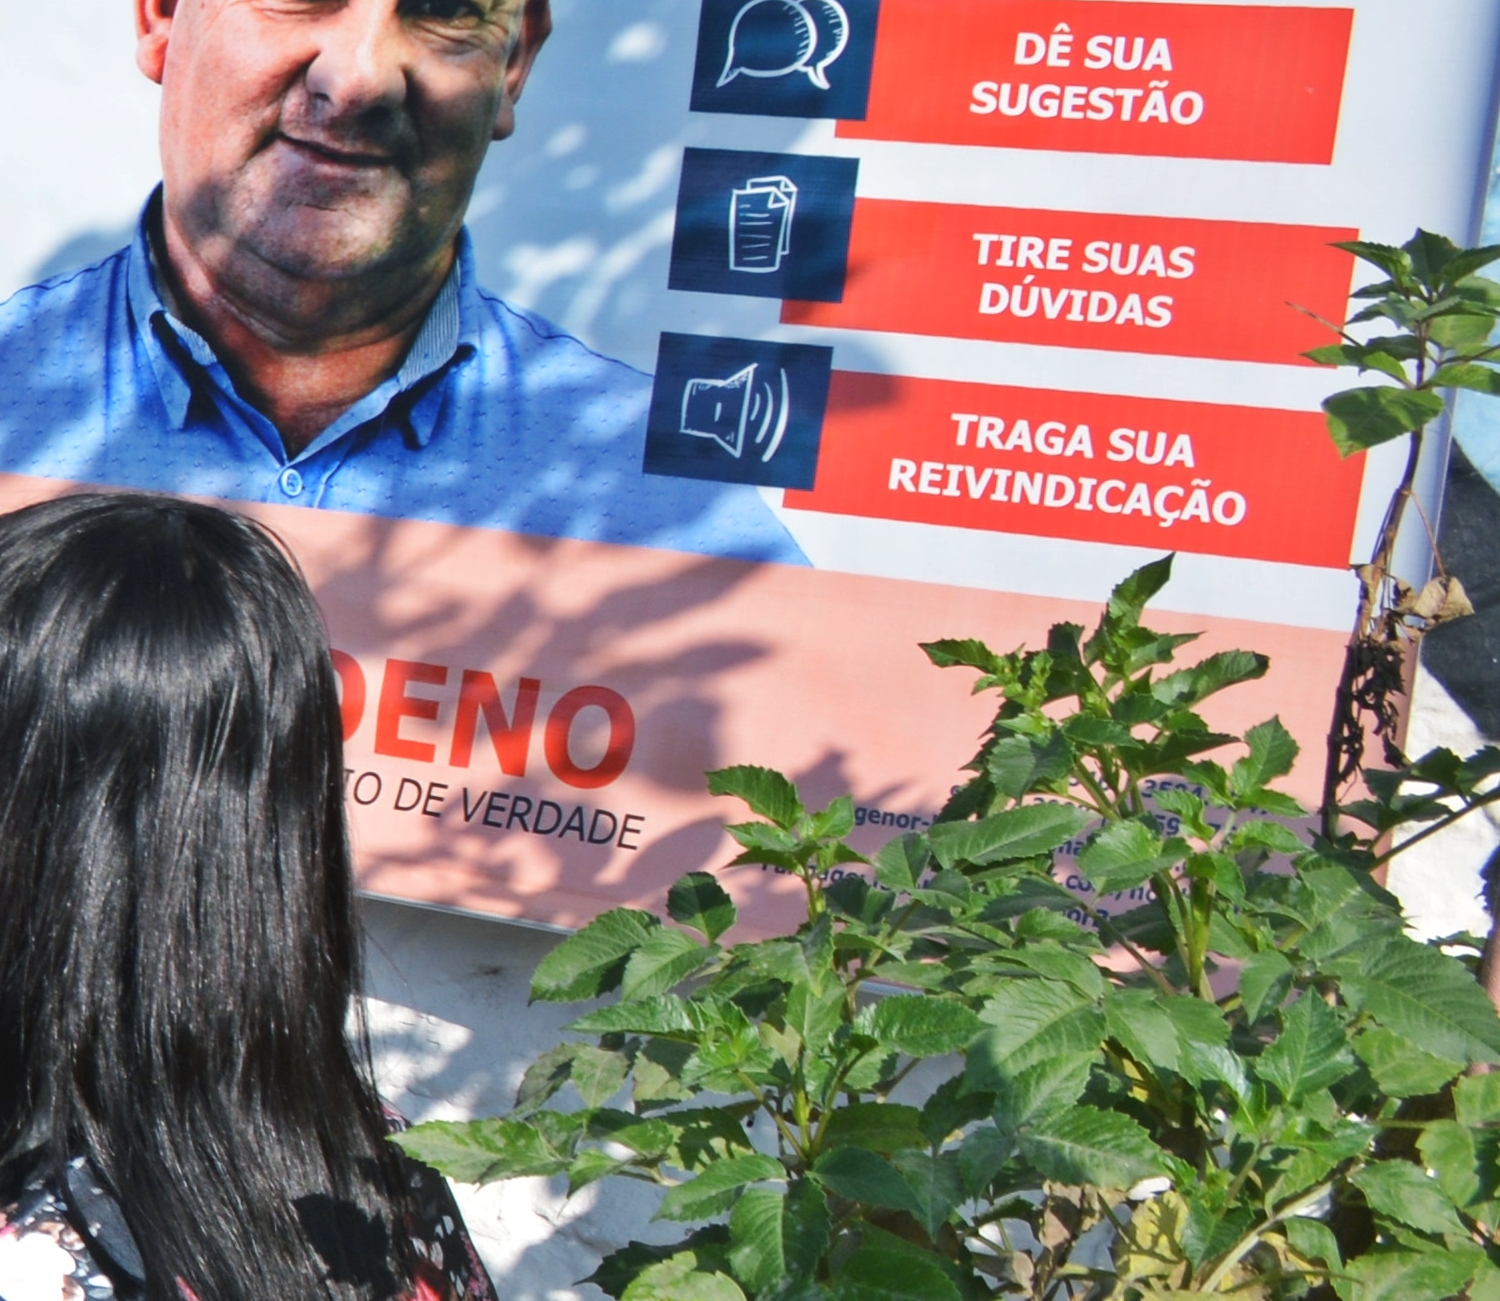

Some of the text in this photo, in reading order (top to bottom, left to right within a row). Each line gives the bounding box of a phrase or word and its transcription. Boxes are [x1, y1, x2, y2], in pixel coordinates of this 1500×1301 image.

[1013, 22, 1173, 72] DÊ SUA
[969, 80, 1204, 126] SUGESTÃO
[972, 233, 1196, 279] TIRE SUAS
[979, 275, 1173, 328] DÚVIDAS
[950, 413, 1195, 468] TRAGA SUA
[888, 458, 1247, 528] REIVINDICAÇÃO
[393, 777, 449, 818] DE
[462, 786, 646, 851] VERDADE
